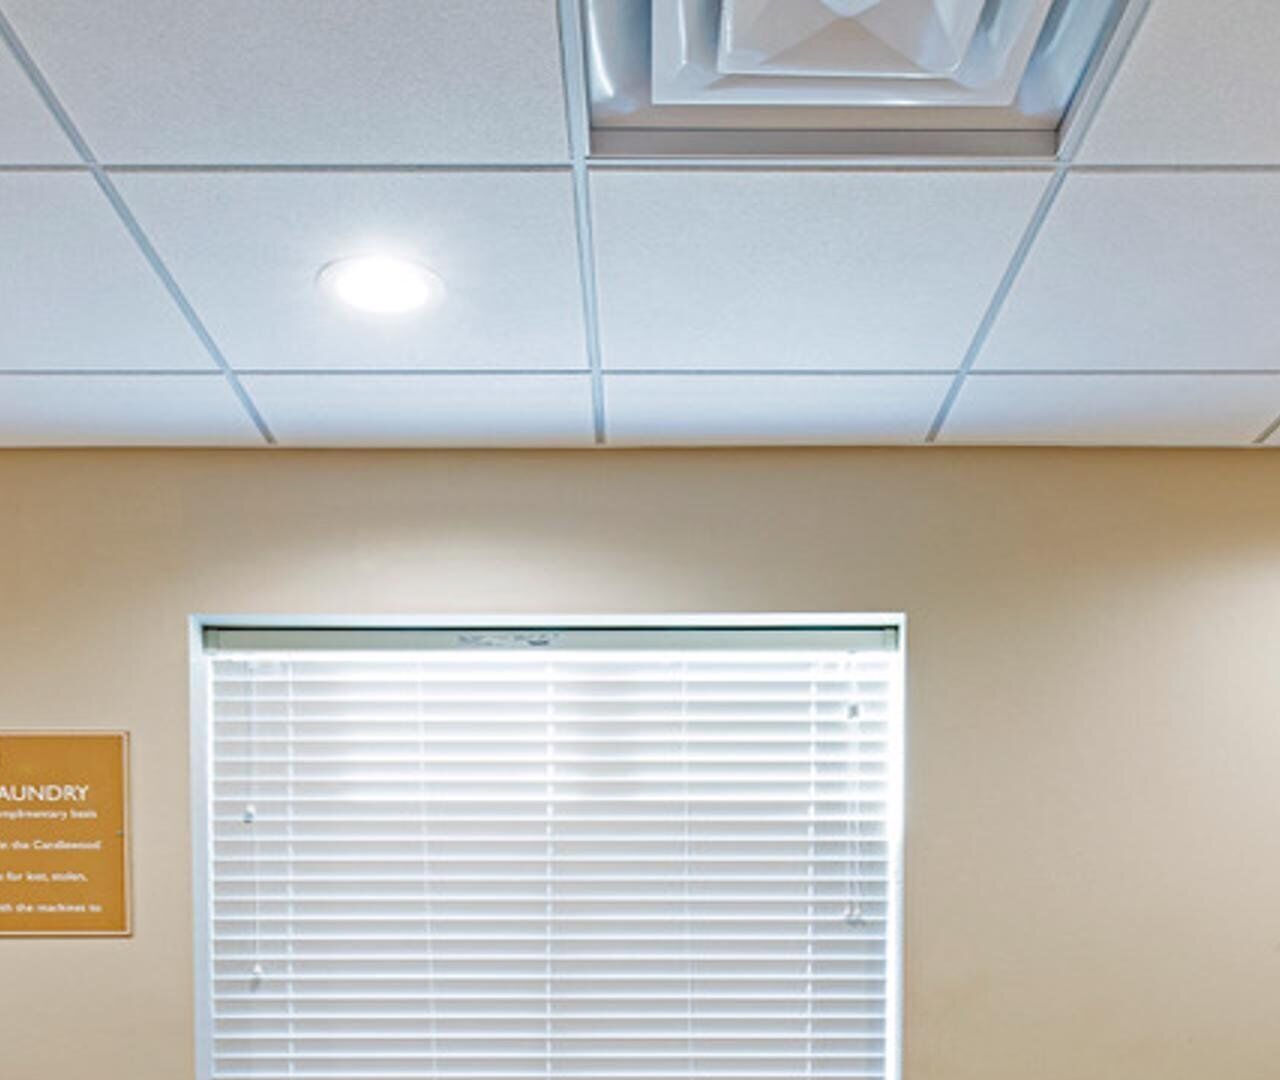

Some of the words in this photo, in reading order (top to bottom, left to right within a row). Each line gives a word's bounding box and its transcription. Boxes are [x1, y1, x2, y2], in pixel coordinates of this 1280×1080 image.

[12, 840, 29, 850] the
[6, 870, 23, 881] for
[16, 902, 33, 912] the
[37, 902, 86, 912] machines
[88, 904, 102, 912] to
